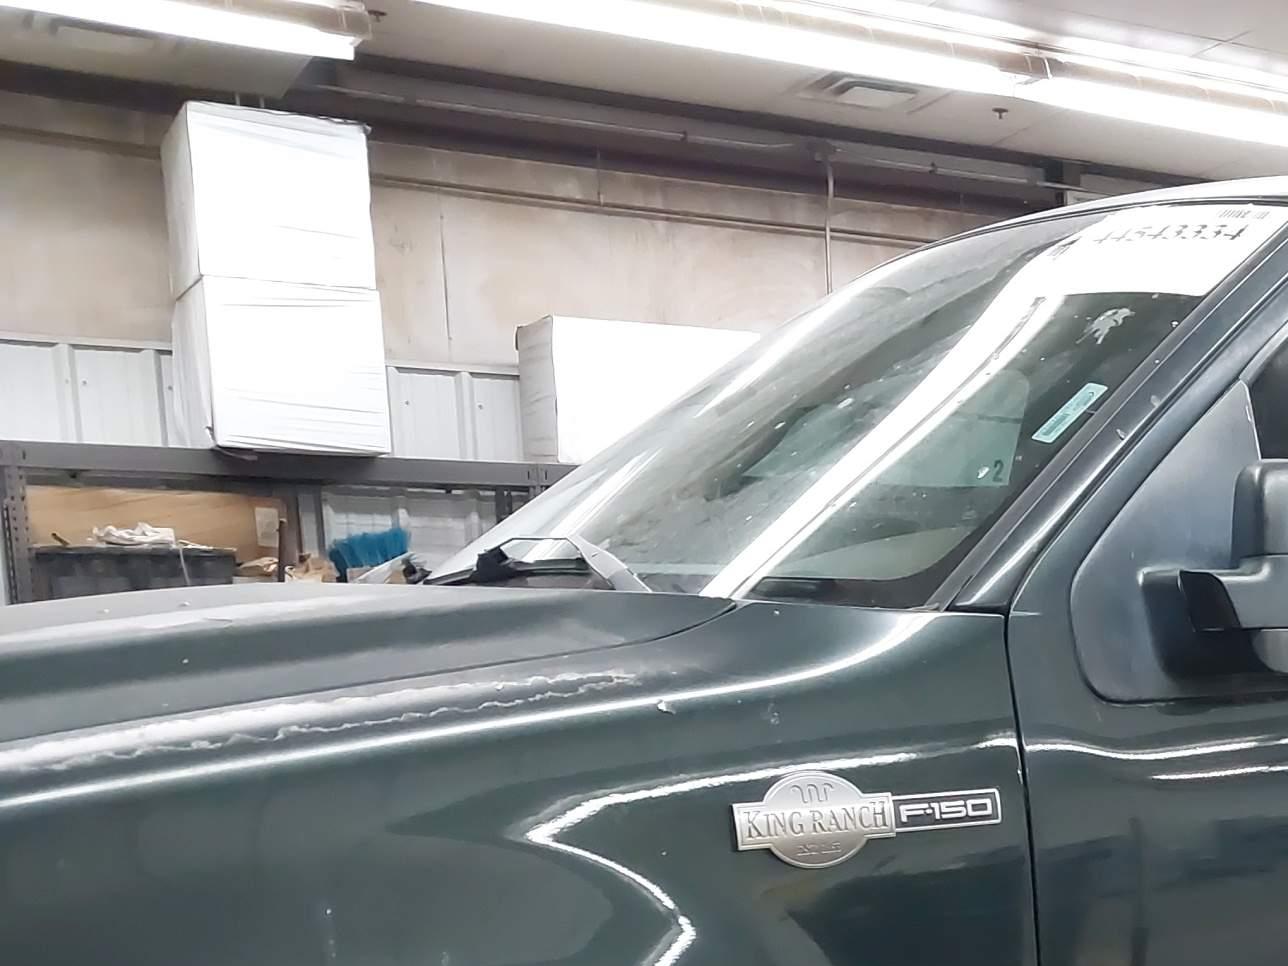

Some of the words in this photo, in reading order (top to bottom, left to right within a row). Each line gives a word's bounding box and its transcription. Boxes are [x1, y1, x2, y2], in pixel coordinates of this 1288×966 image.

[742, 808, 805, 839] KING
[812, 800, 890, 832] RANCH
[899, 798, 992, 823] F-150
